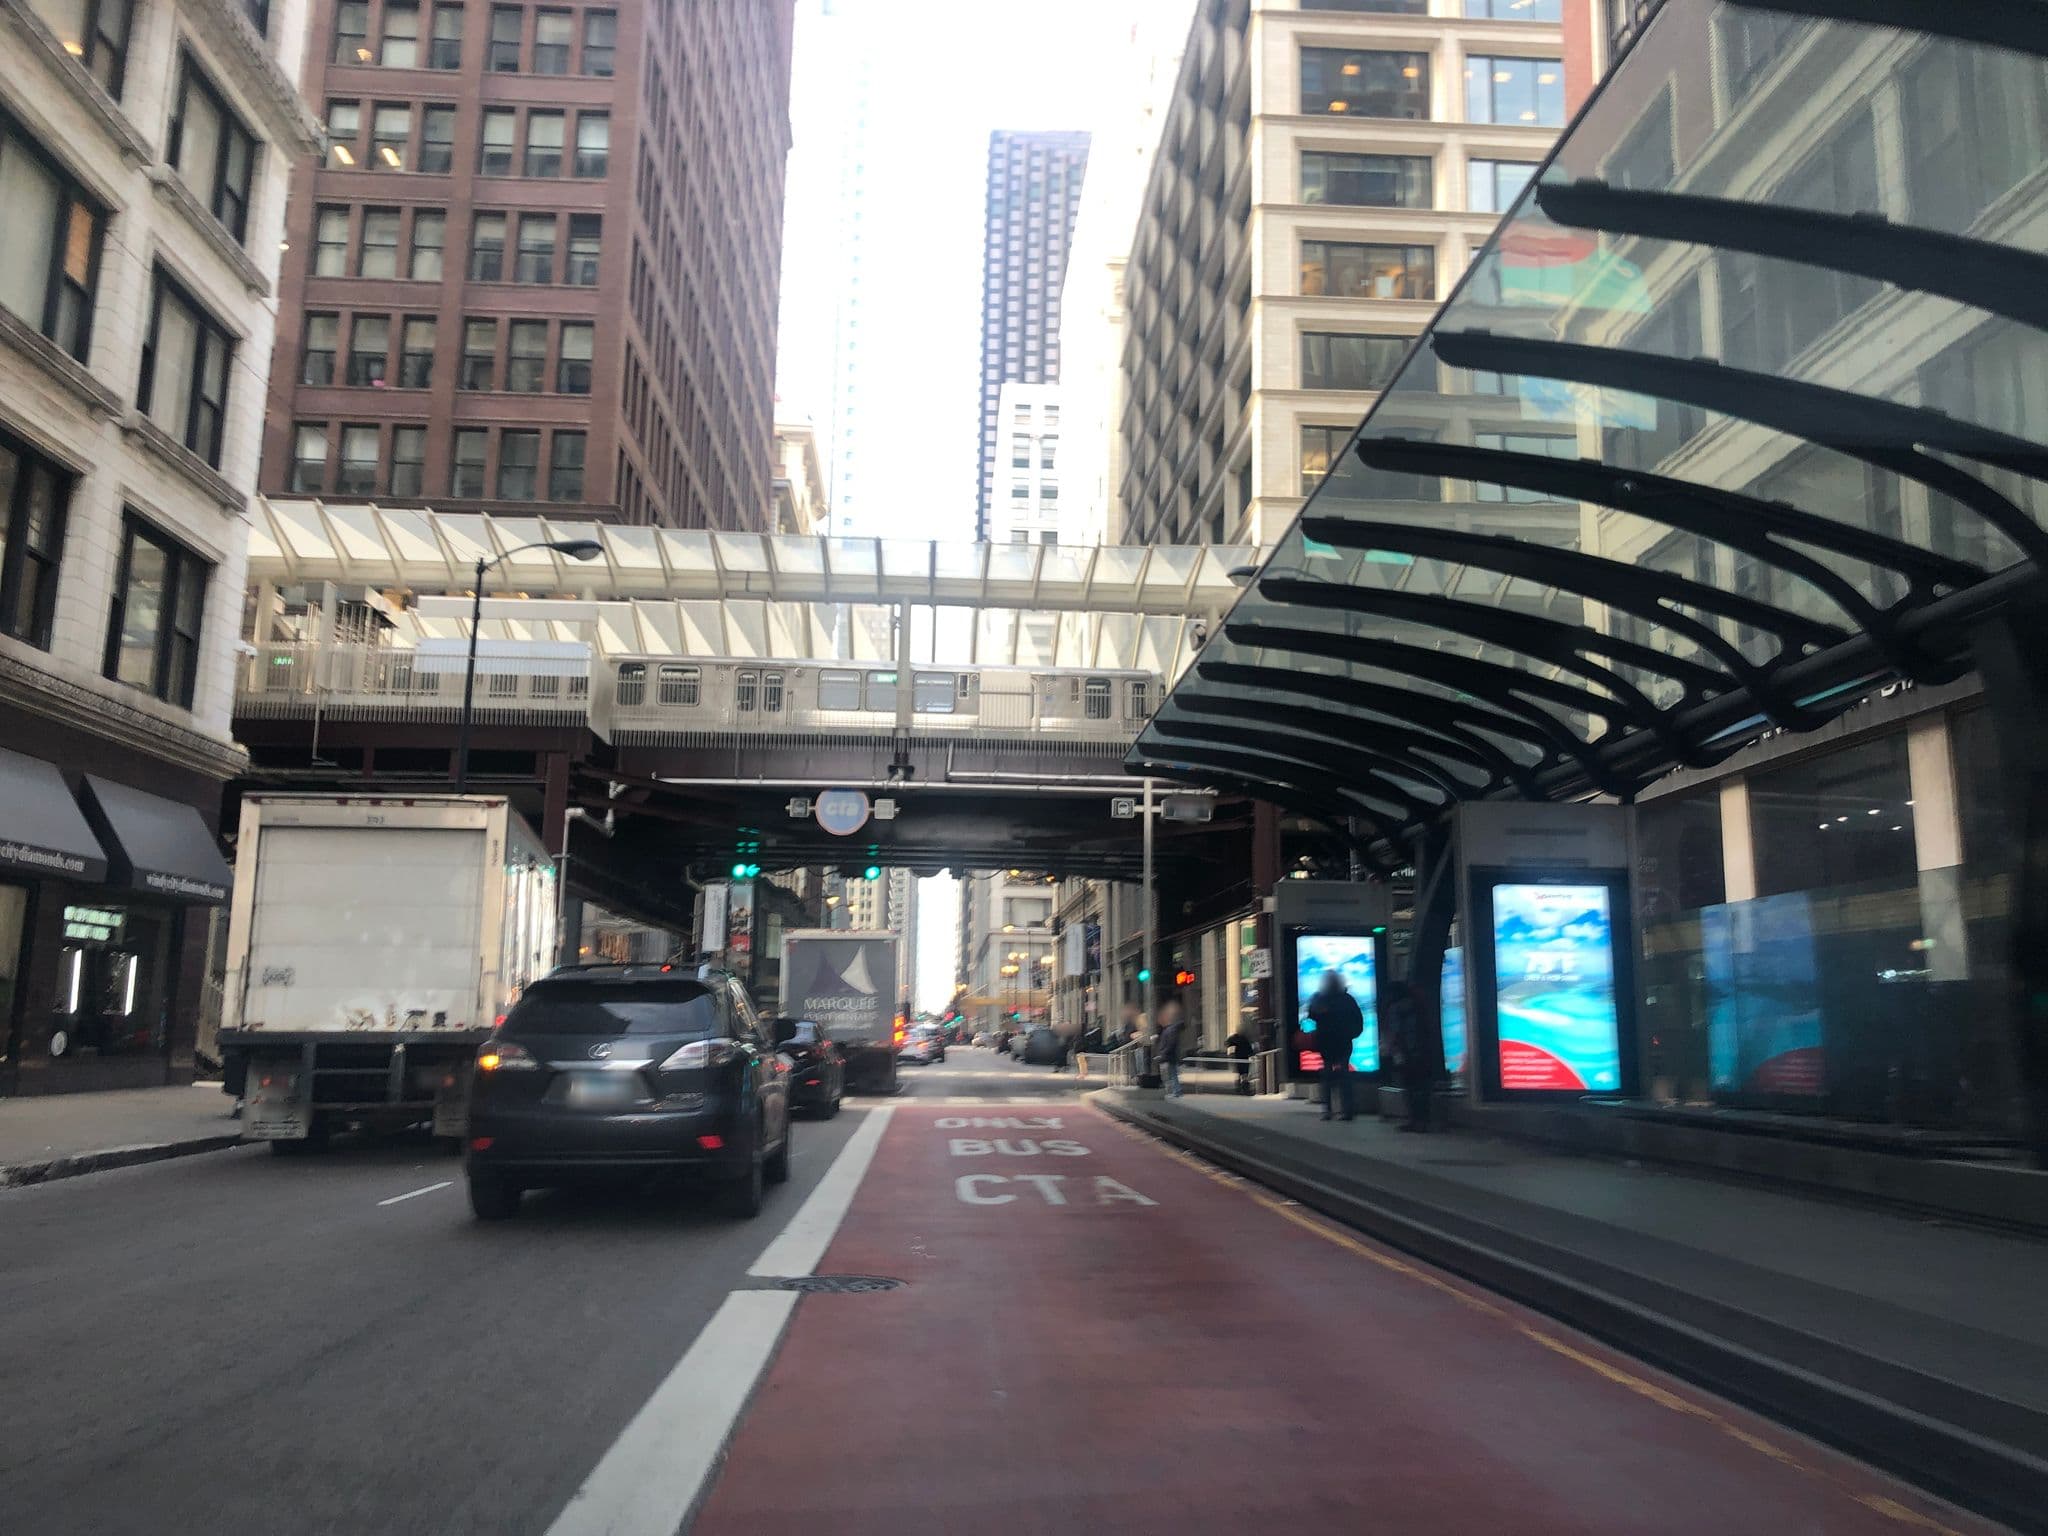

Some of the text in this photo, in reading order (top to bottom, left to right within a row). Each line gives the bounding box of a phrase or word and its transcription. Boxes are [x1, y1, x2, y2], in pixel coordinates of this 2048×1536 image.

[803, 996, 881, 1011] MARQUEE
[934, 1117, 1065, 1129] ONLY
[949, 1138, 1091, 1156] BUS
[955, 1174, 1161, 1206] CTA
